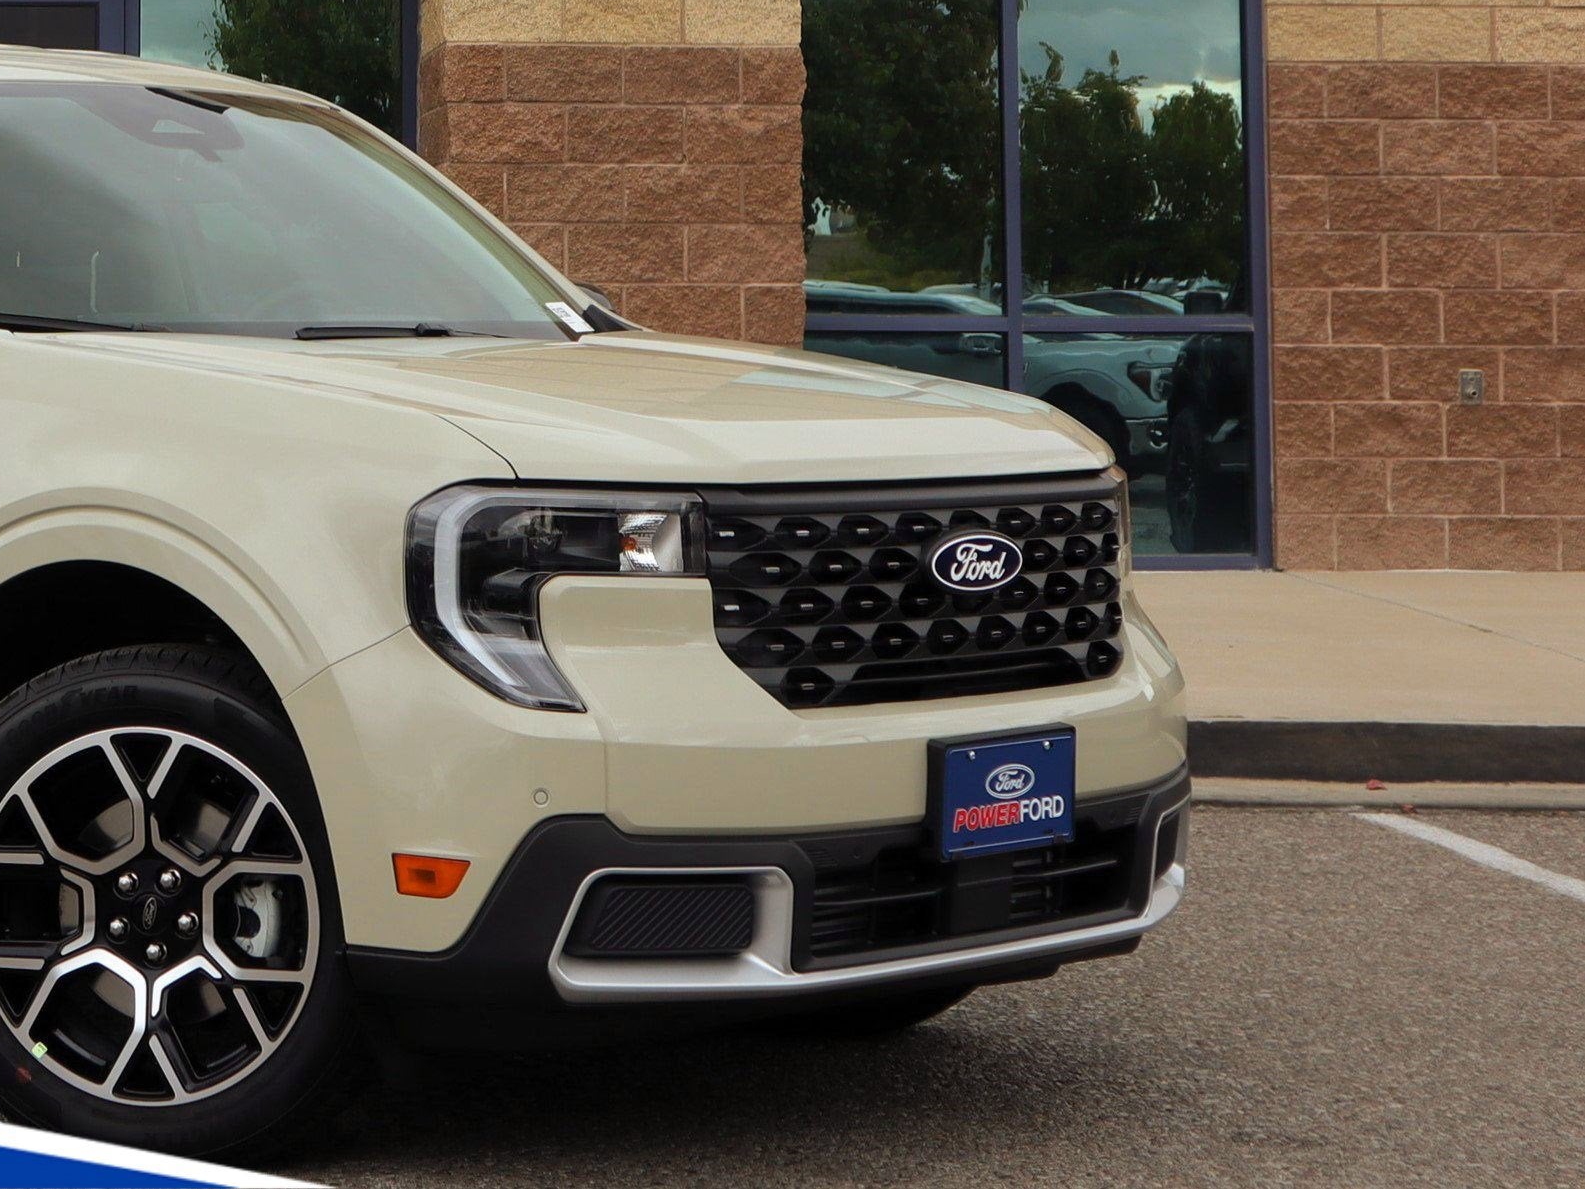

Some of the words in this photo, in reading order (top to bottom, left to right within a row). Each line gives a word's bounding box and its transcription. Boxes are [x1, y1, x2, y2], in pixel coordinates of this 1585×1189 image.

[950, 542, 1007, 582] Ford
[995, 769, 1026, 793] Ford
[952, 794, 1065, 834] POWERFORD
